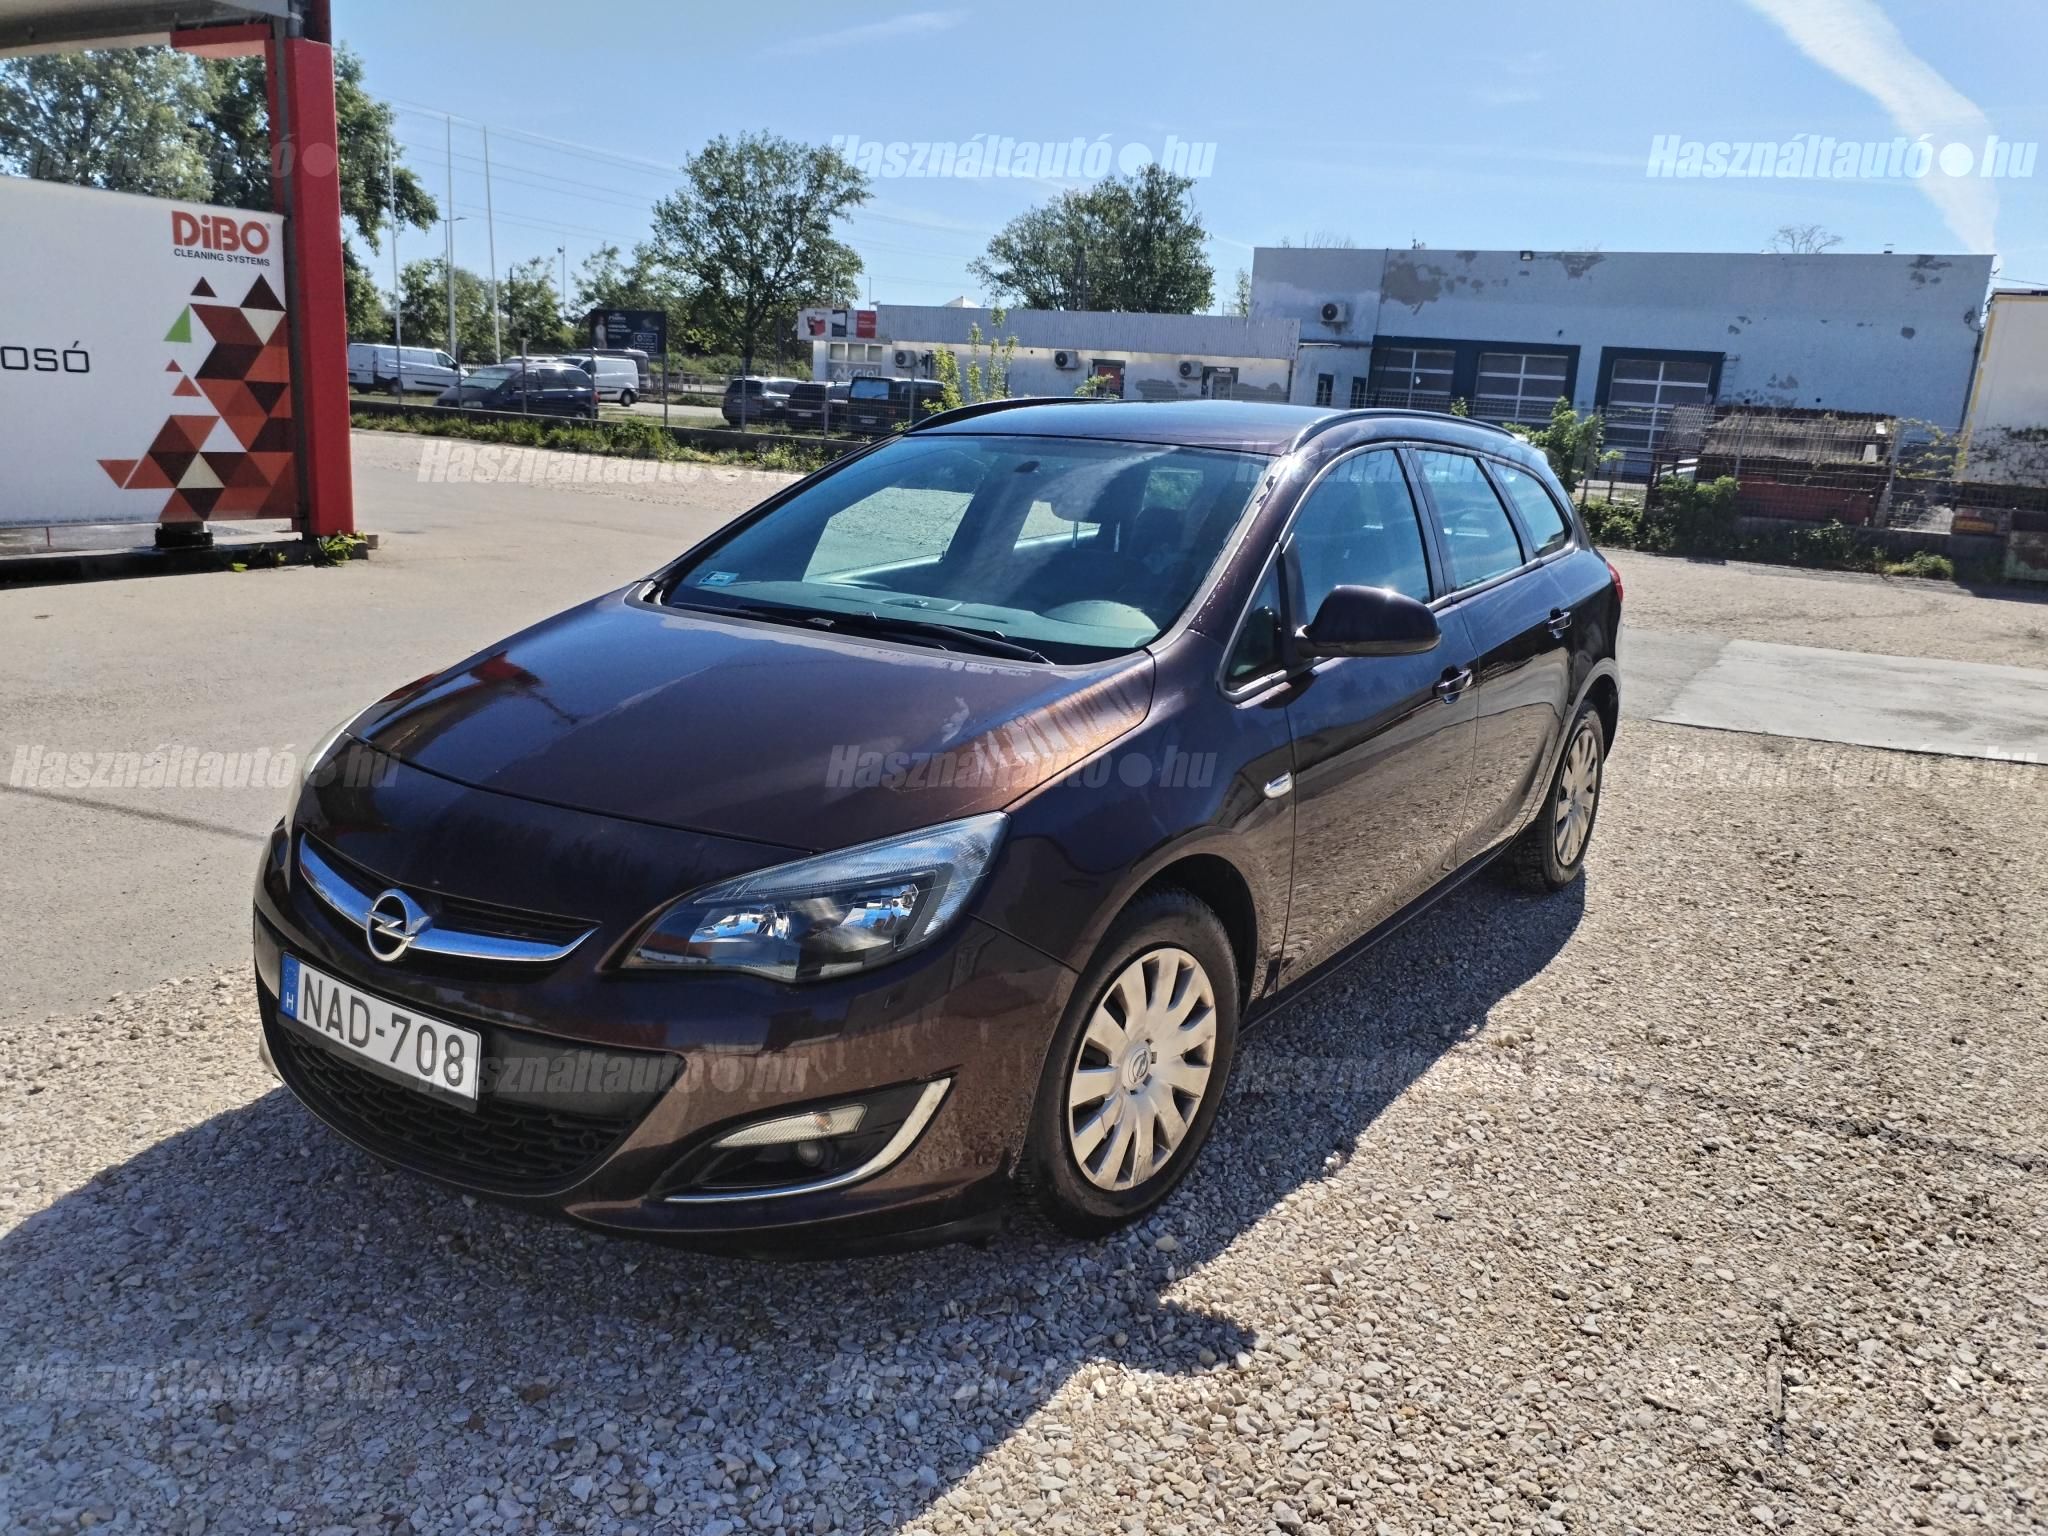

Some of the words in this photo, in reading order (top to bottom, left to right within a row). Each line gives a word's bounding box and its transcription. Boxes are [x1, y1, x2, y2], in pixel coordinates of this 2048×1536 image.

[174, 248, 225, 262] CLEANING
[226, 254, 270, 266] SYSTEMS
[303, 971, 465, 1087] NAD-708
